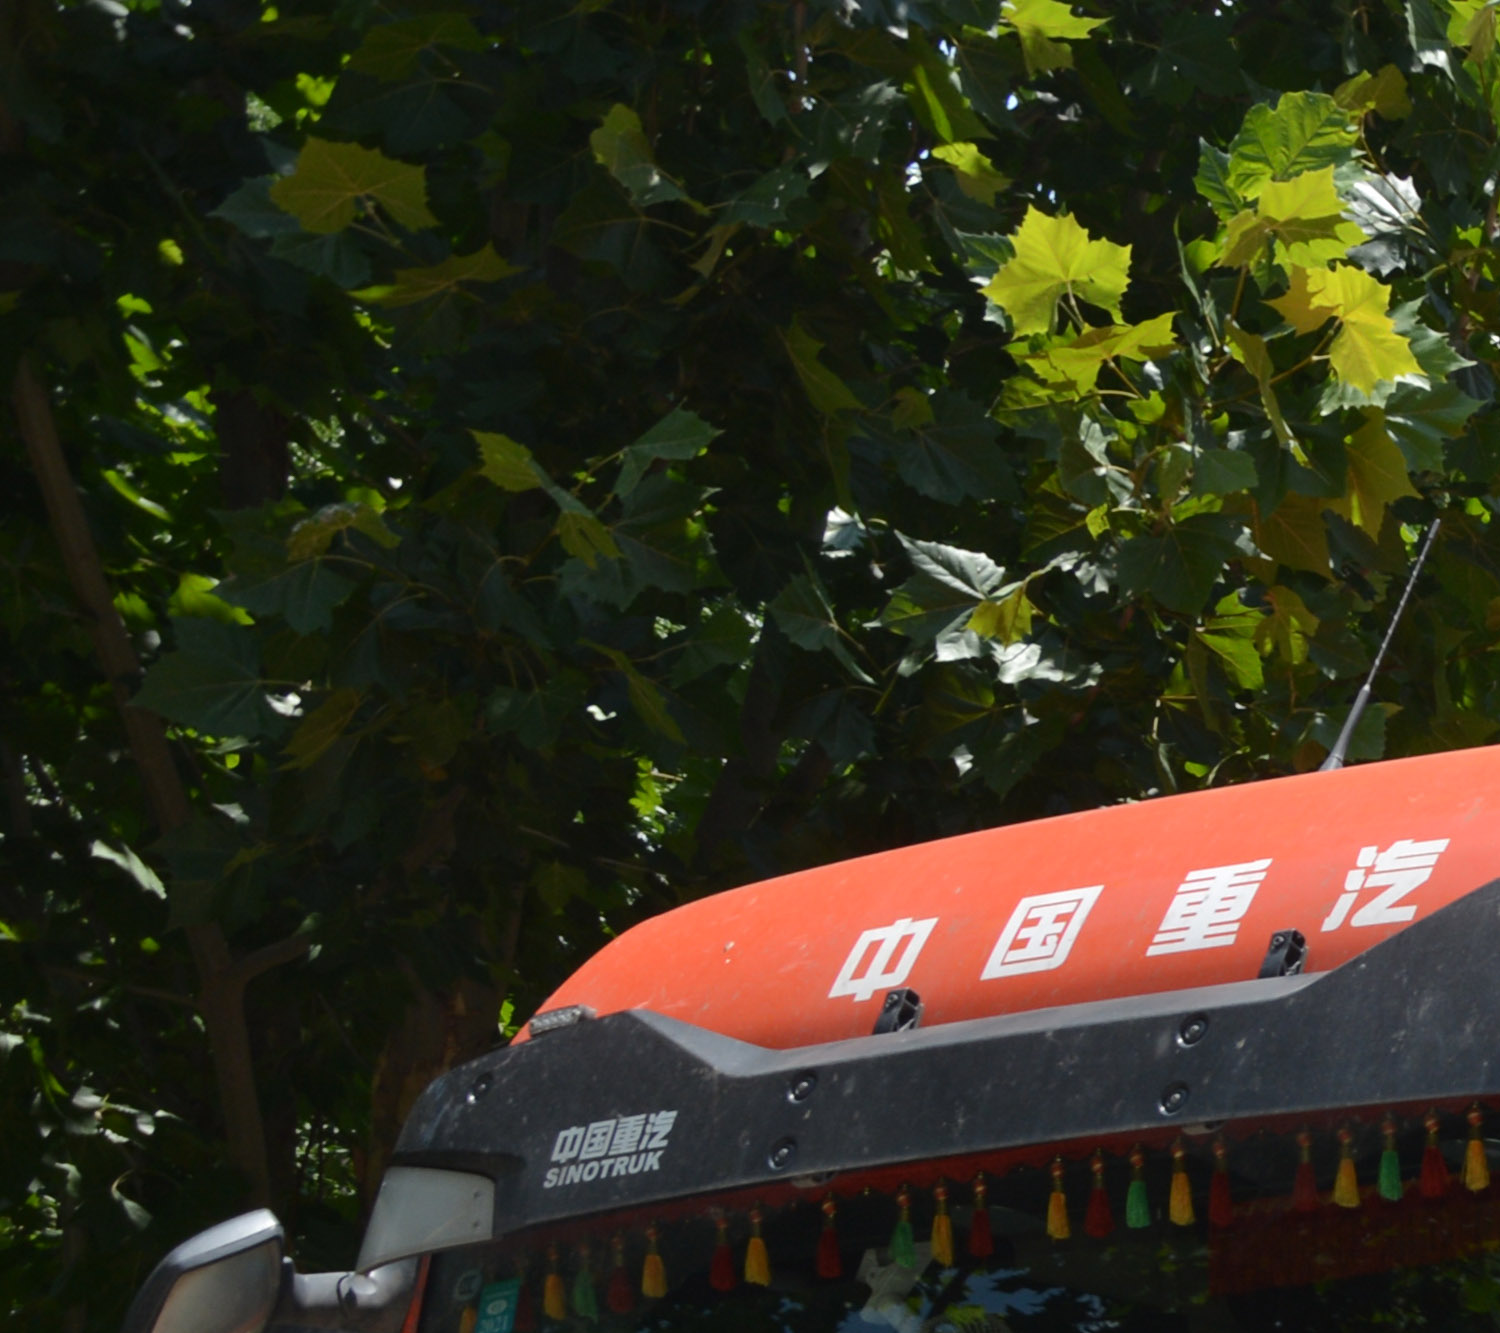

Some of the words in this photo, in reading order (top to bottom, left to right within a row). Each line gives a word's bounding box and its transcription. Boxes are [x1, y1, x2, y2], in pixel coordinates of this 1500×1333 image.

[828, 838, 1450, 1002] 中国重汽
[551, 1110, 679, 1164] 中国重汽
[543, 1150, 664, 1189] SINOTRUK
